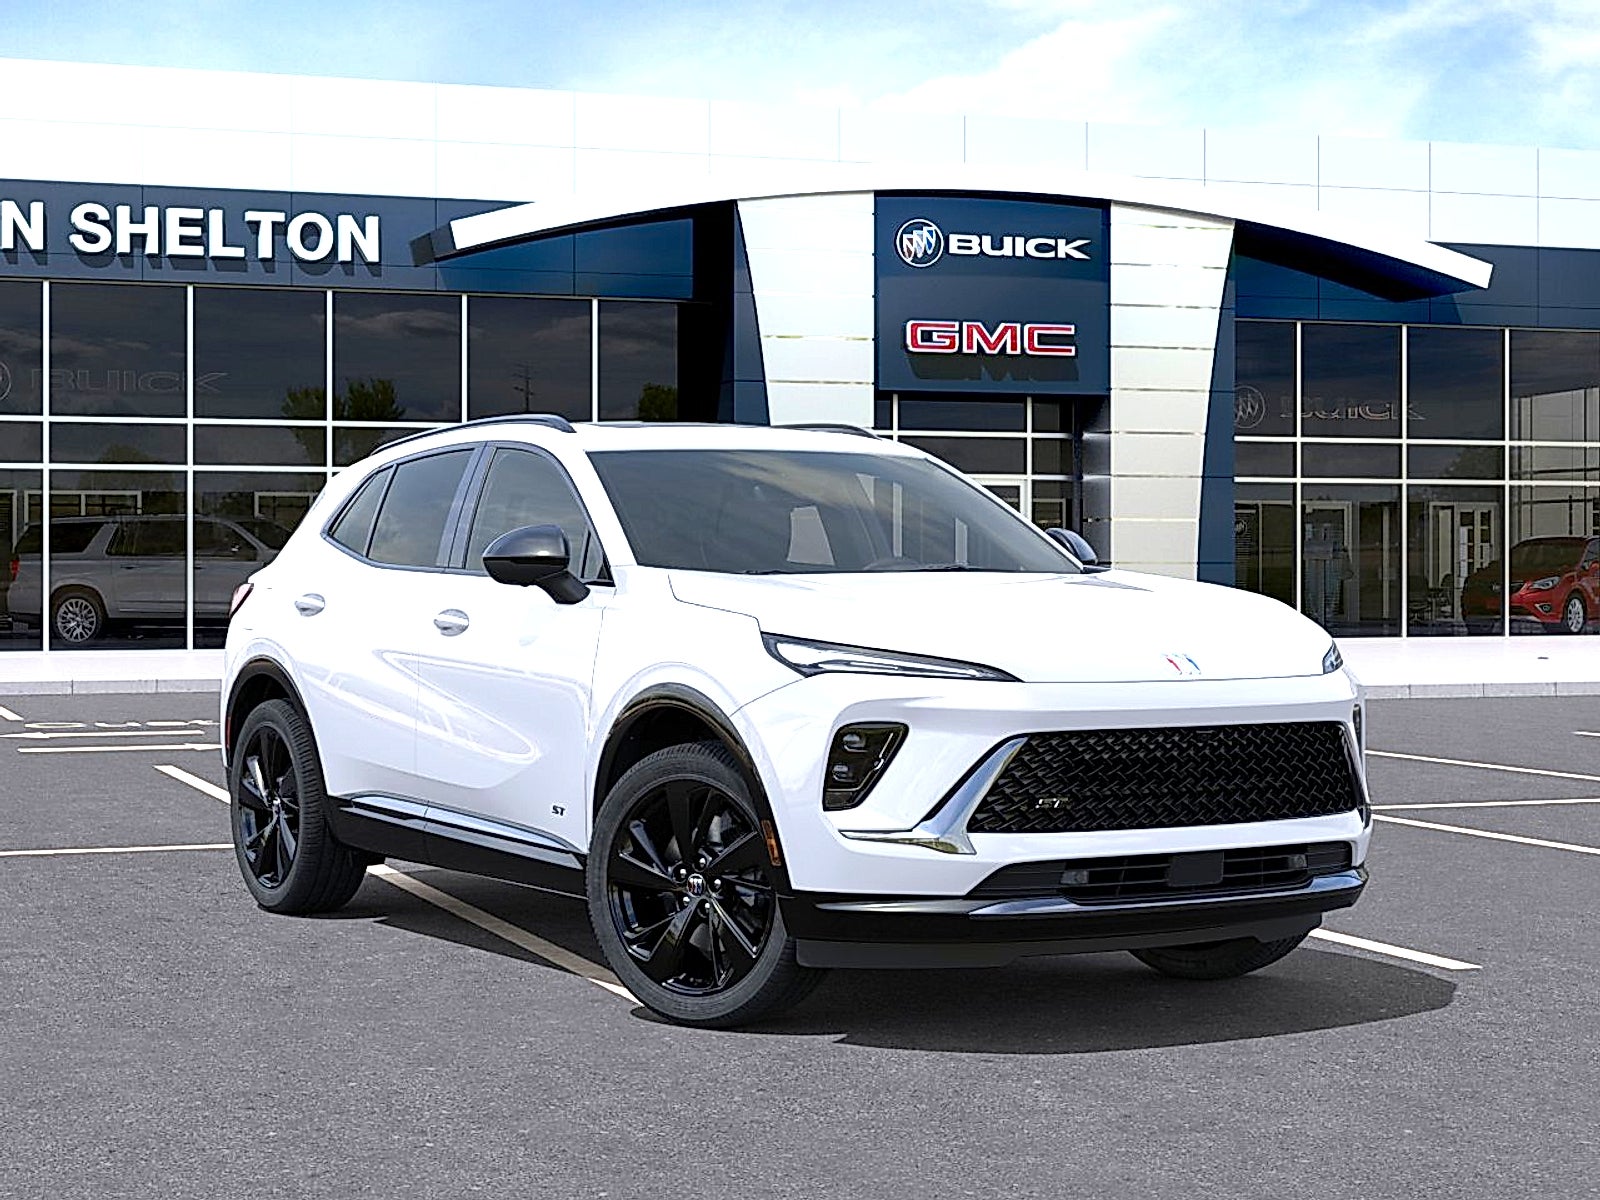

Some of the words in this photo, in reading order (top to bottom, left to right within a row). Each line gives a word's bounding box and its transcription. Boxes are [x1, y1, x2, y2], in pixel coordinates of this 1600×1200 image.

[69, 202, 380, 263] SHELTON
[948, 233, 1092, 260] BUICK
[906, 319, 1076, 357] GMC
[31, 368, 228, 393] BUICK
[551, 804, 567, 817] ST
